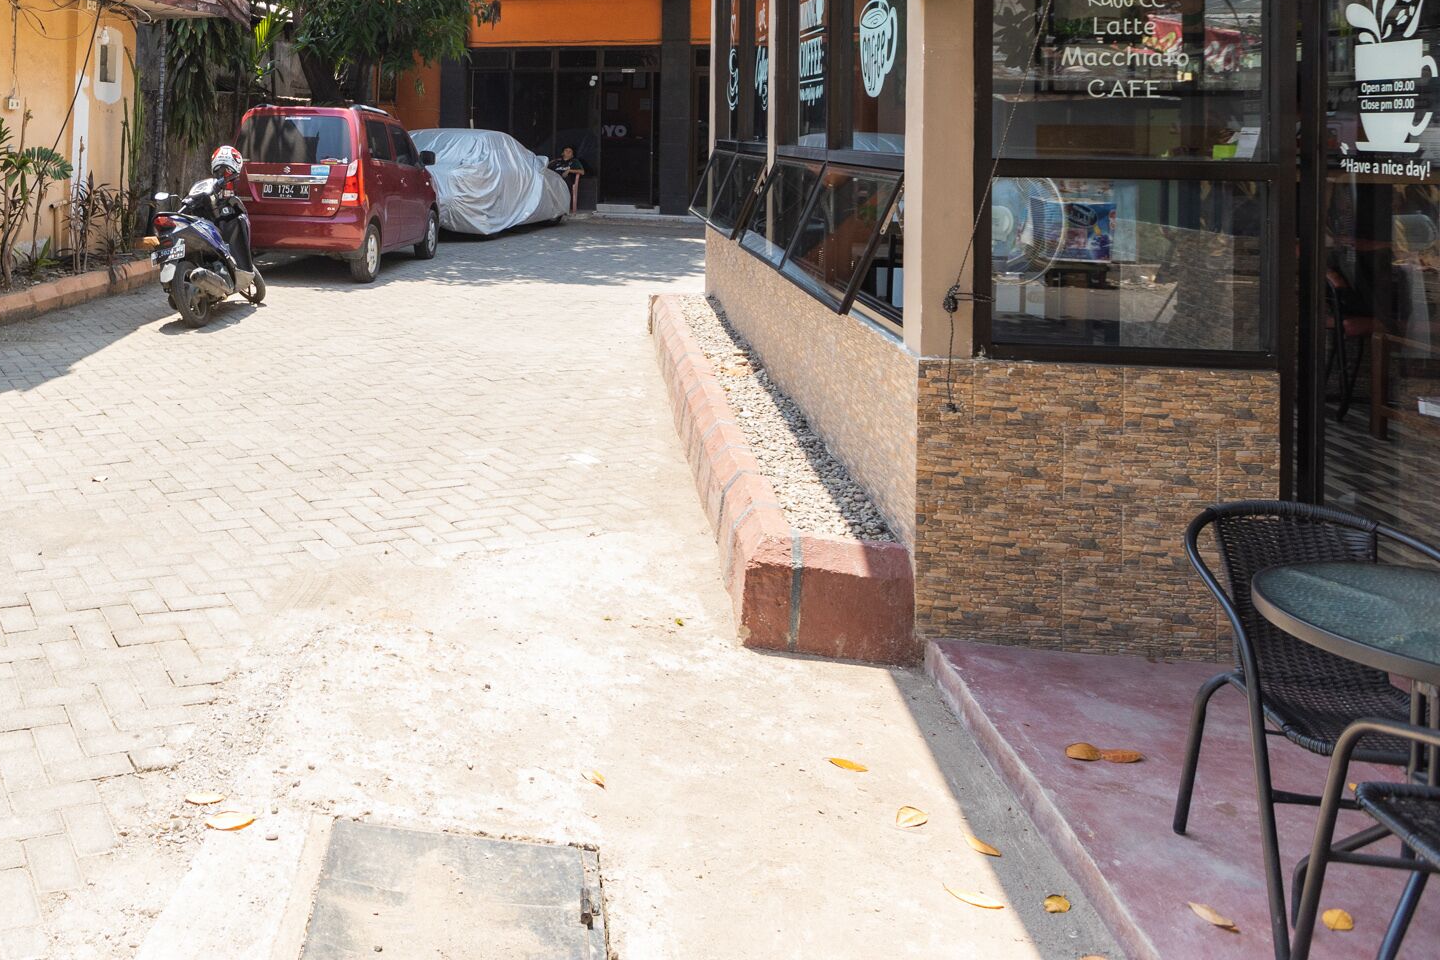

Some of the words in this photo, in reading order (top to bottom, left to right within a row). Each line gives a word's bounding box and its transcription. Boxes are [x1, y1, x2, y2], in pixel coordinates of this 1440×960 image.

[1093, 16, 1157, 35] Latte
[1061, 46, 1190, 67] Macchiato
[1087, 79, 1161, 98] CAFE
[1361, 83, 1380, 94] Open
[1381, 84, 1393, 92] am
[1393, 81, 1415, 91] 09.00
[1361, 100, 1379, 109] Close
[1380, 101, 1393, 111] pm
[1393, 98, 1415, 109] 09.00
[1345, 159, 1371, 174] Have
[1372, 163, 1380, 174] a
[1381, 159, 1404, 176] nice
[1405, 160, 1431, 181] day!
[278, 185, 294, 194] 1754
